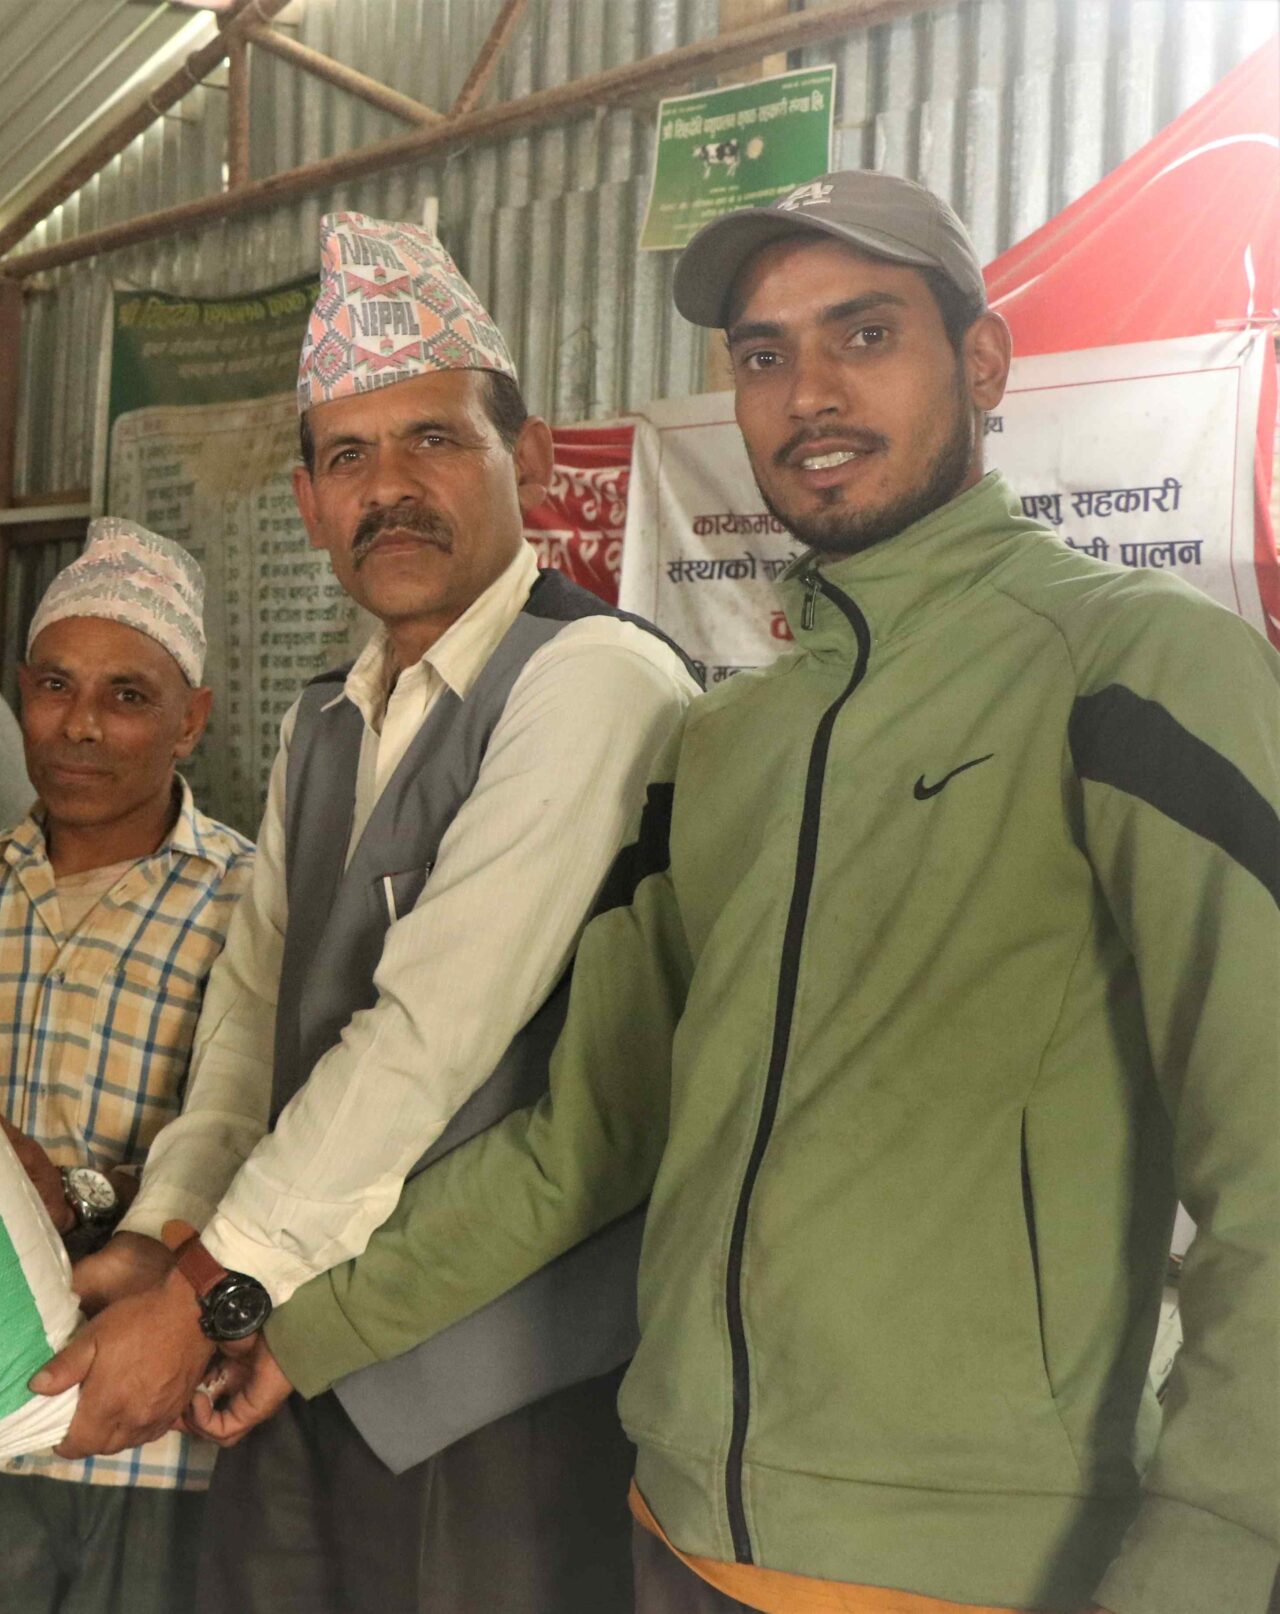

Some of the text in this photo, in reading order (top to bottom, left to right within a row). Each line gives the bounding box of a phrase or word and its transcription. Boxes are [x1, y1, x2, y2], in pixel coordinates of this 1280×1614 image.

[347, 301, 420, 337] NEPAL
[1020, 477, 1183, 525] पशु सहकारी
[667, 550, 758, 584] संस्थाको
[1119, 539, 1204, 568] पालन
